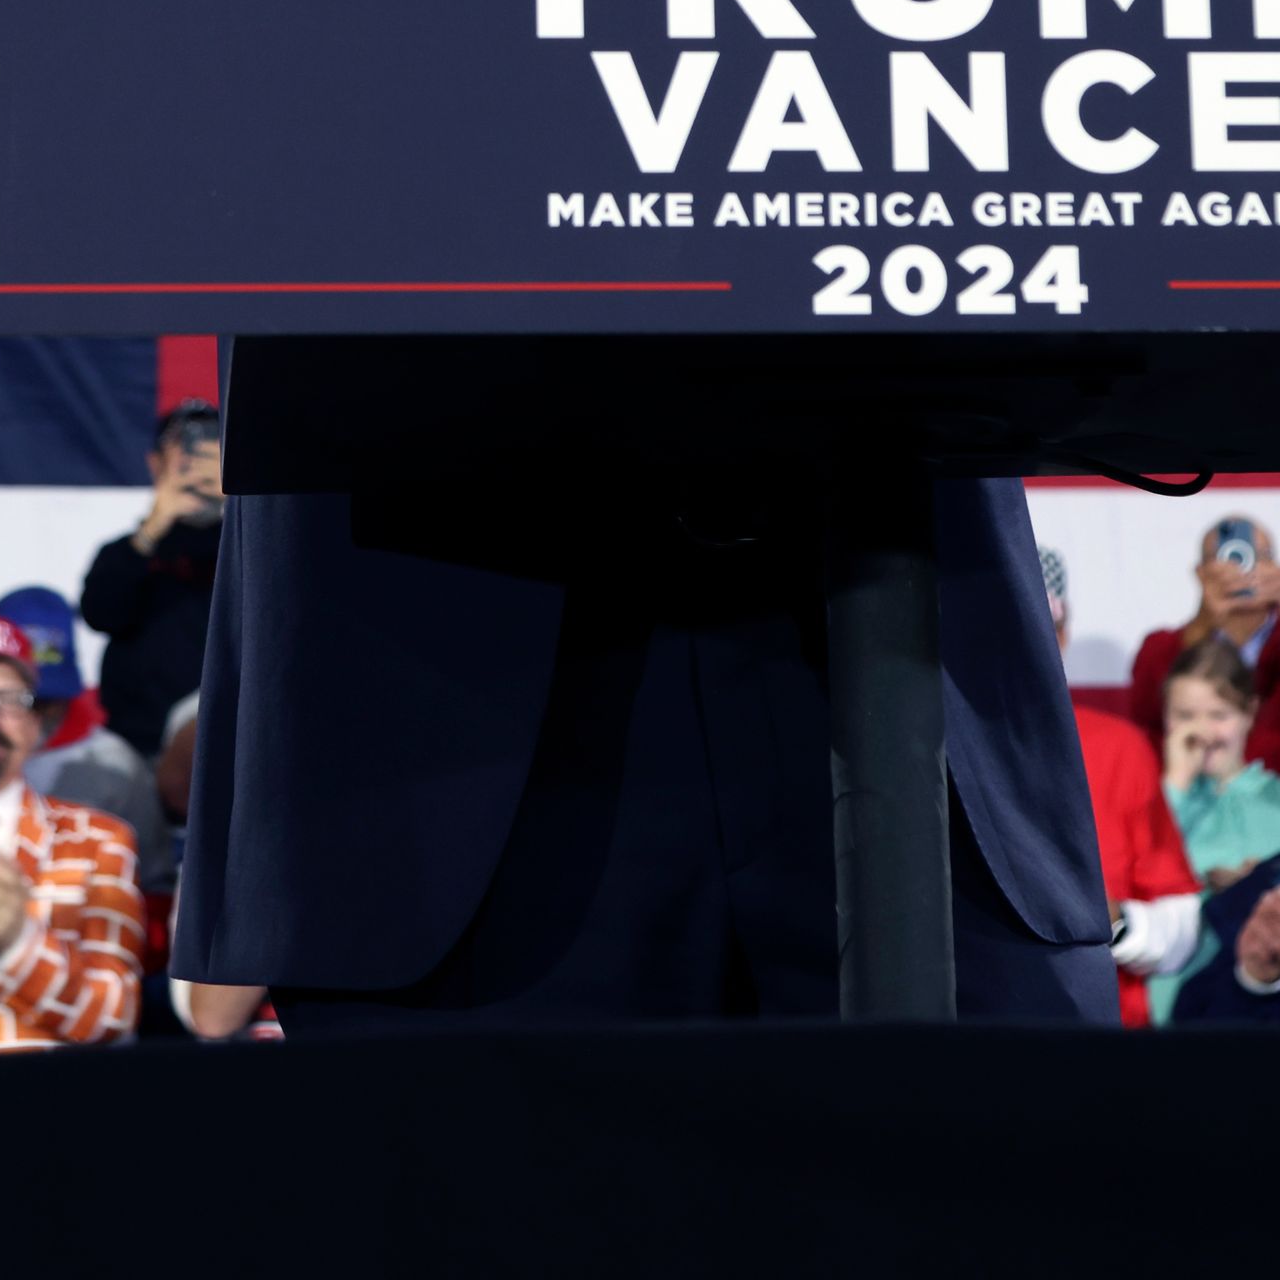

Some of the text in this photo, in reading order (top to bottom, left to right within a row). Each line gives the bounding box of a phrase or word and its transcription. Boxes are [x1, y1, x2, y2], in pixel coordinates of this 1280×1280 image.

[547, 192, 695, 228] MAKE
[713, 192, 954, 228] AMERICA
[972, 191, 1143, 228] GREAT
[812, 244, 1089, 316] 2024
